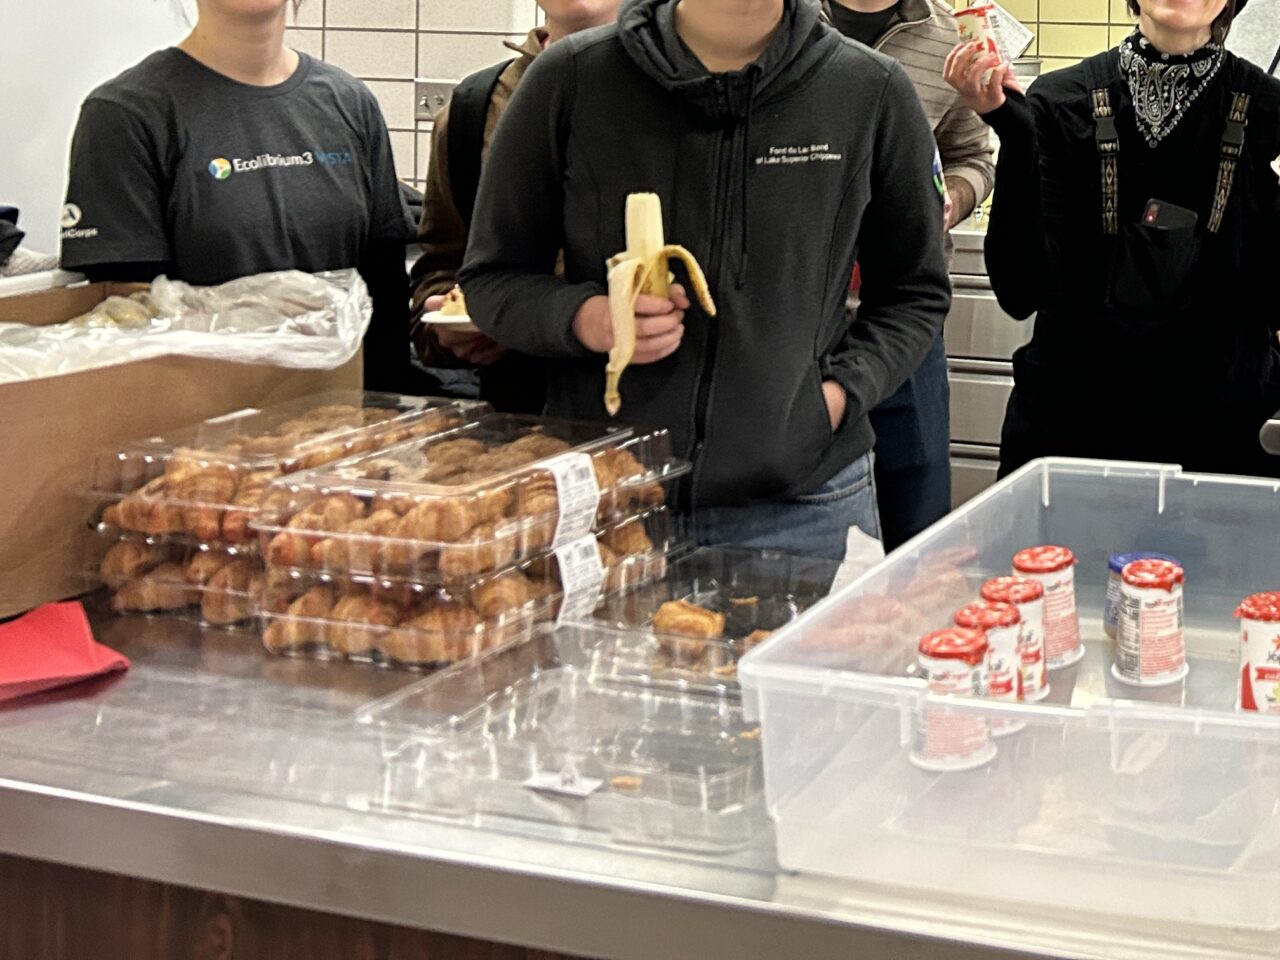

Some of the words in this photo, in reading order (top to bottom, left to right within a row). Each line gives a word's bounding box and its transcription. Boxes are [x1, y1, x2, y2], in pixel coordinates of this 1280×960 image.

[769, 146, 788, 155] Fond
[810, 143, 829, 152] Band
[232, 151, 314, 172] Ecolibrium3
